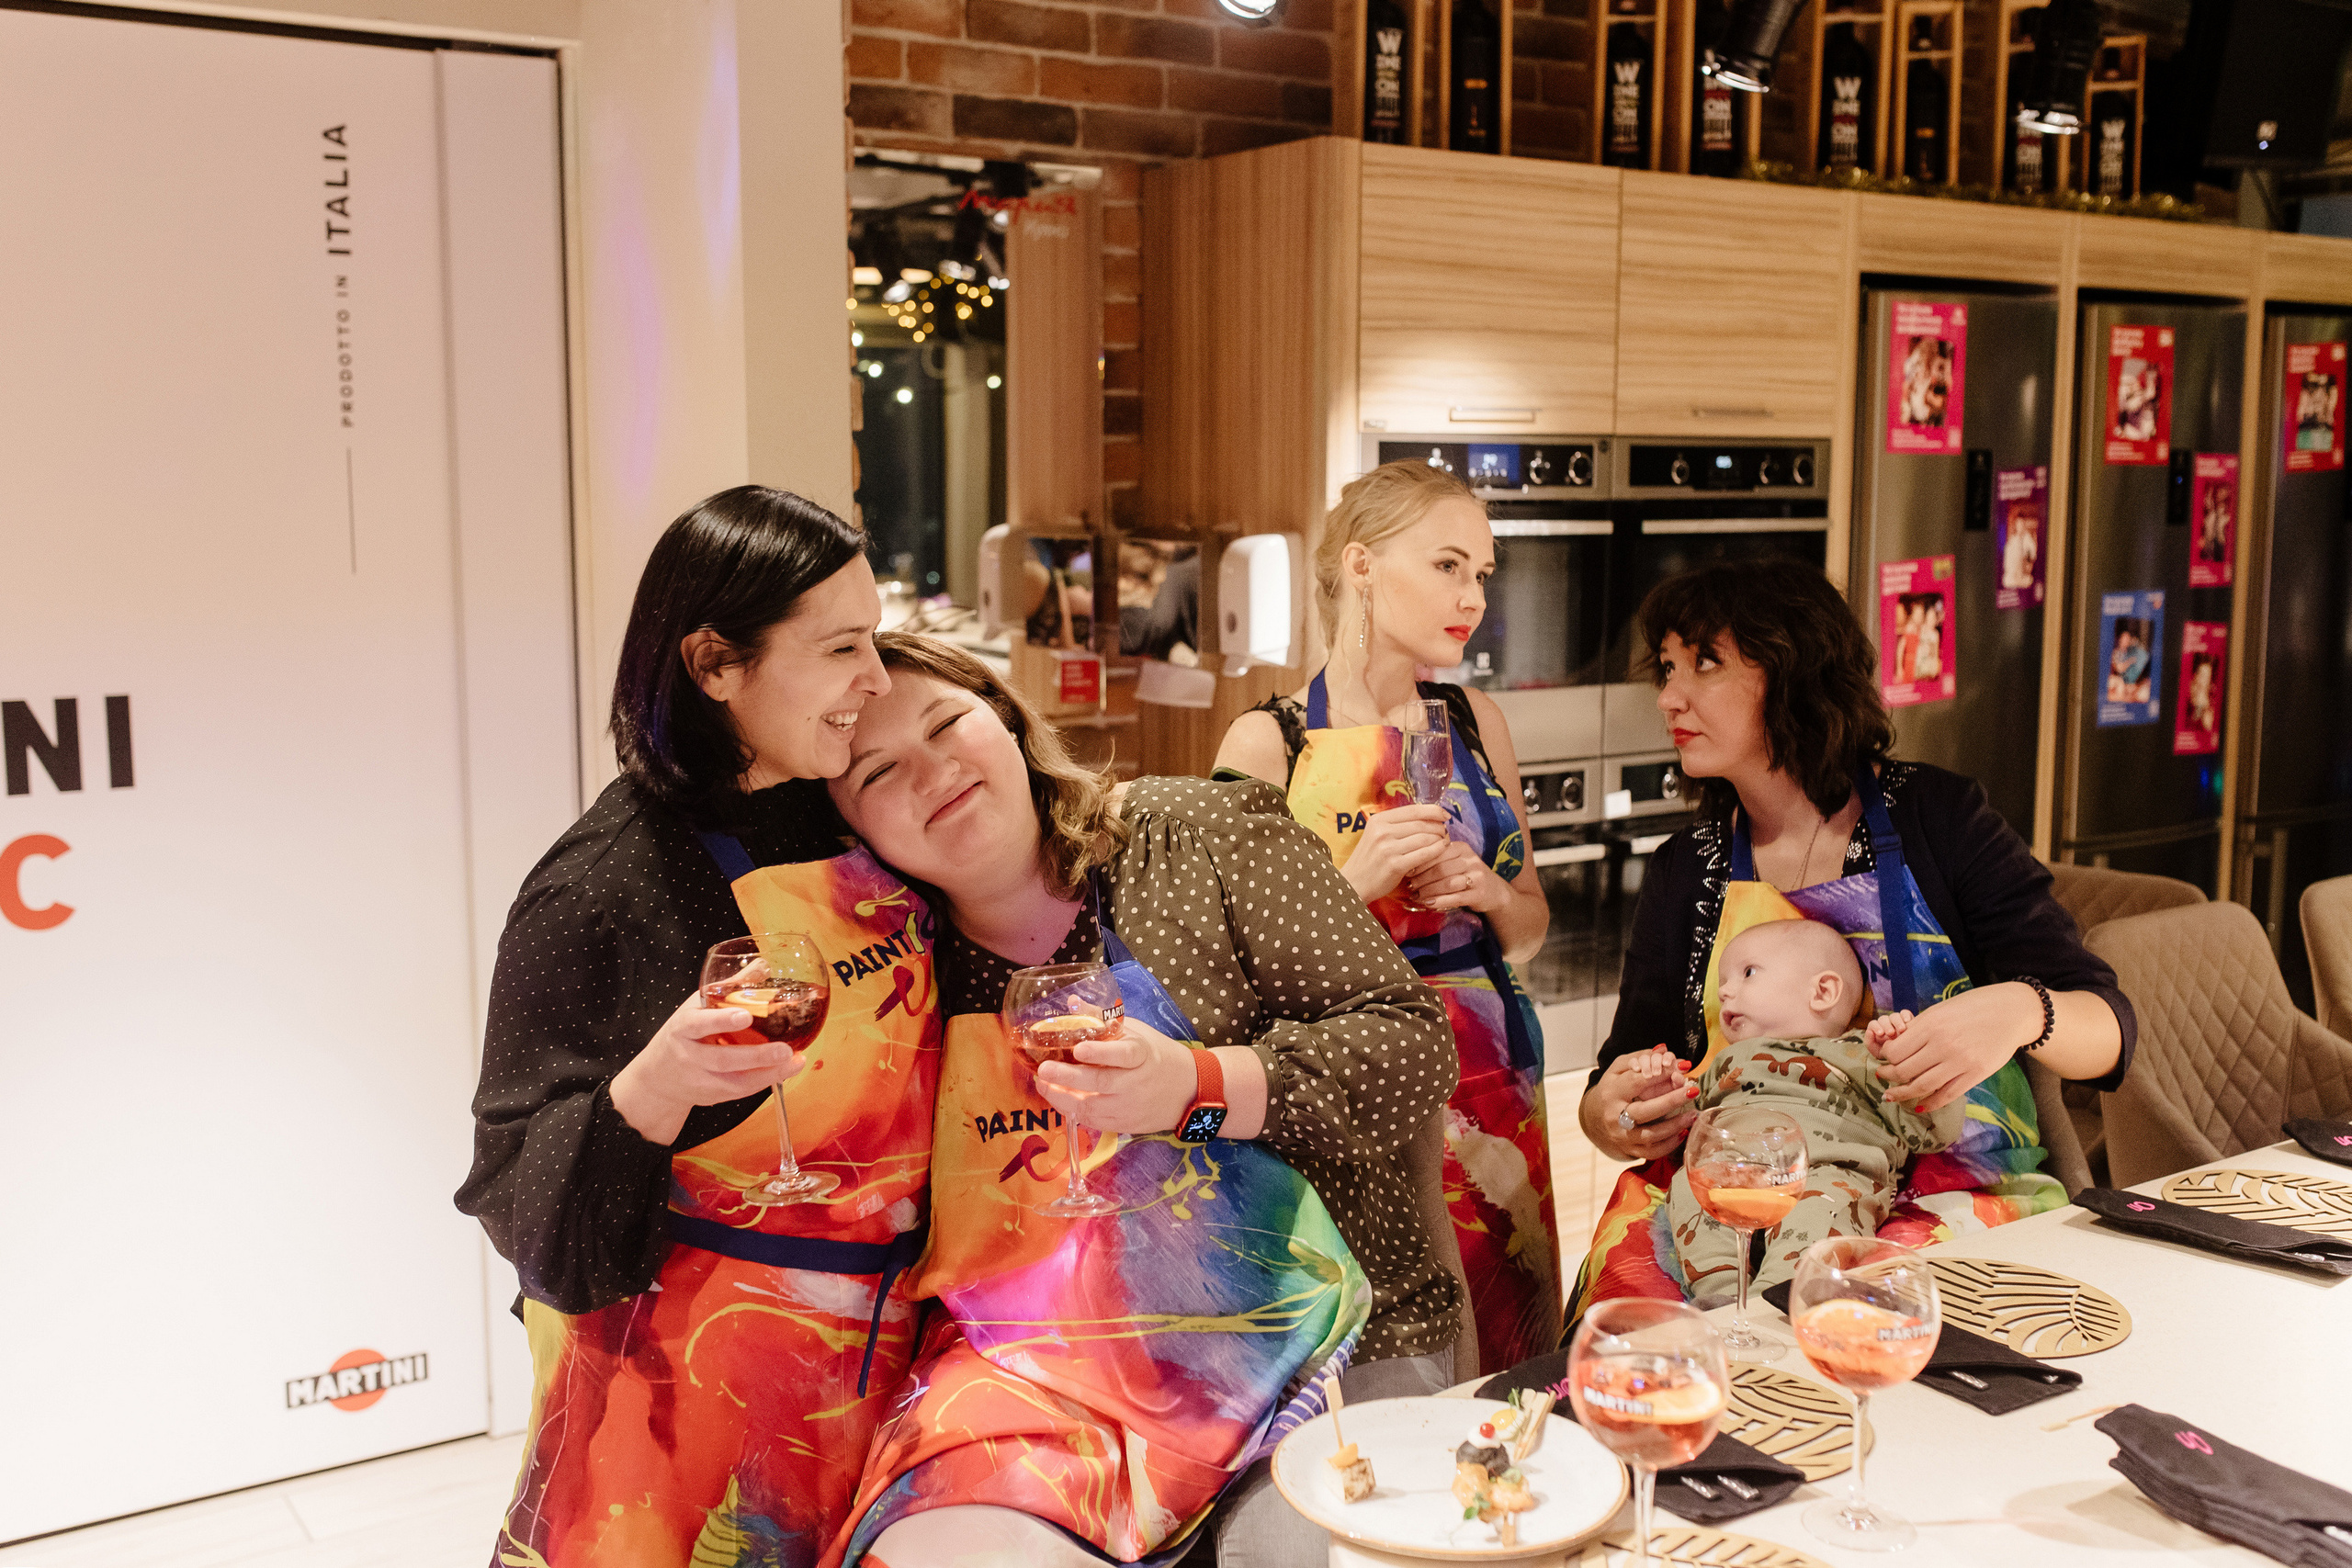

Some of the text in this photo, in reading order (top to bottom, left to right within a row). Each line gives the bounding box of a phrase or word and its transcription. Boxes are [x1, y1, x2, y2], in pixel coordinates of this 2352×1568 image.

[323, 124, 354, 428] PRODOTTO IN ITALIA
[2, 695, 134, 795] NI
[0, 834, 75, 931] C
[288, 1354, 427, 1407] MARTINI
[1583, 1385, 1654, 1416] MARTINI
